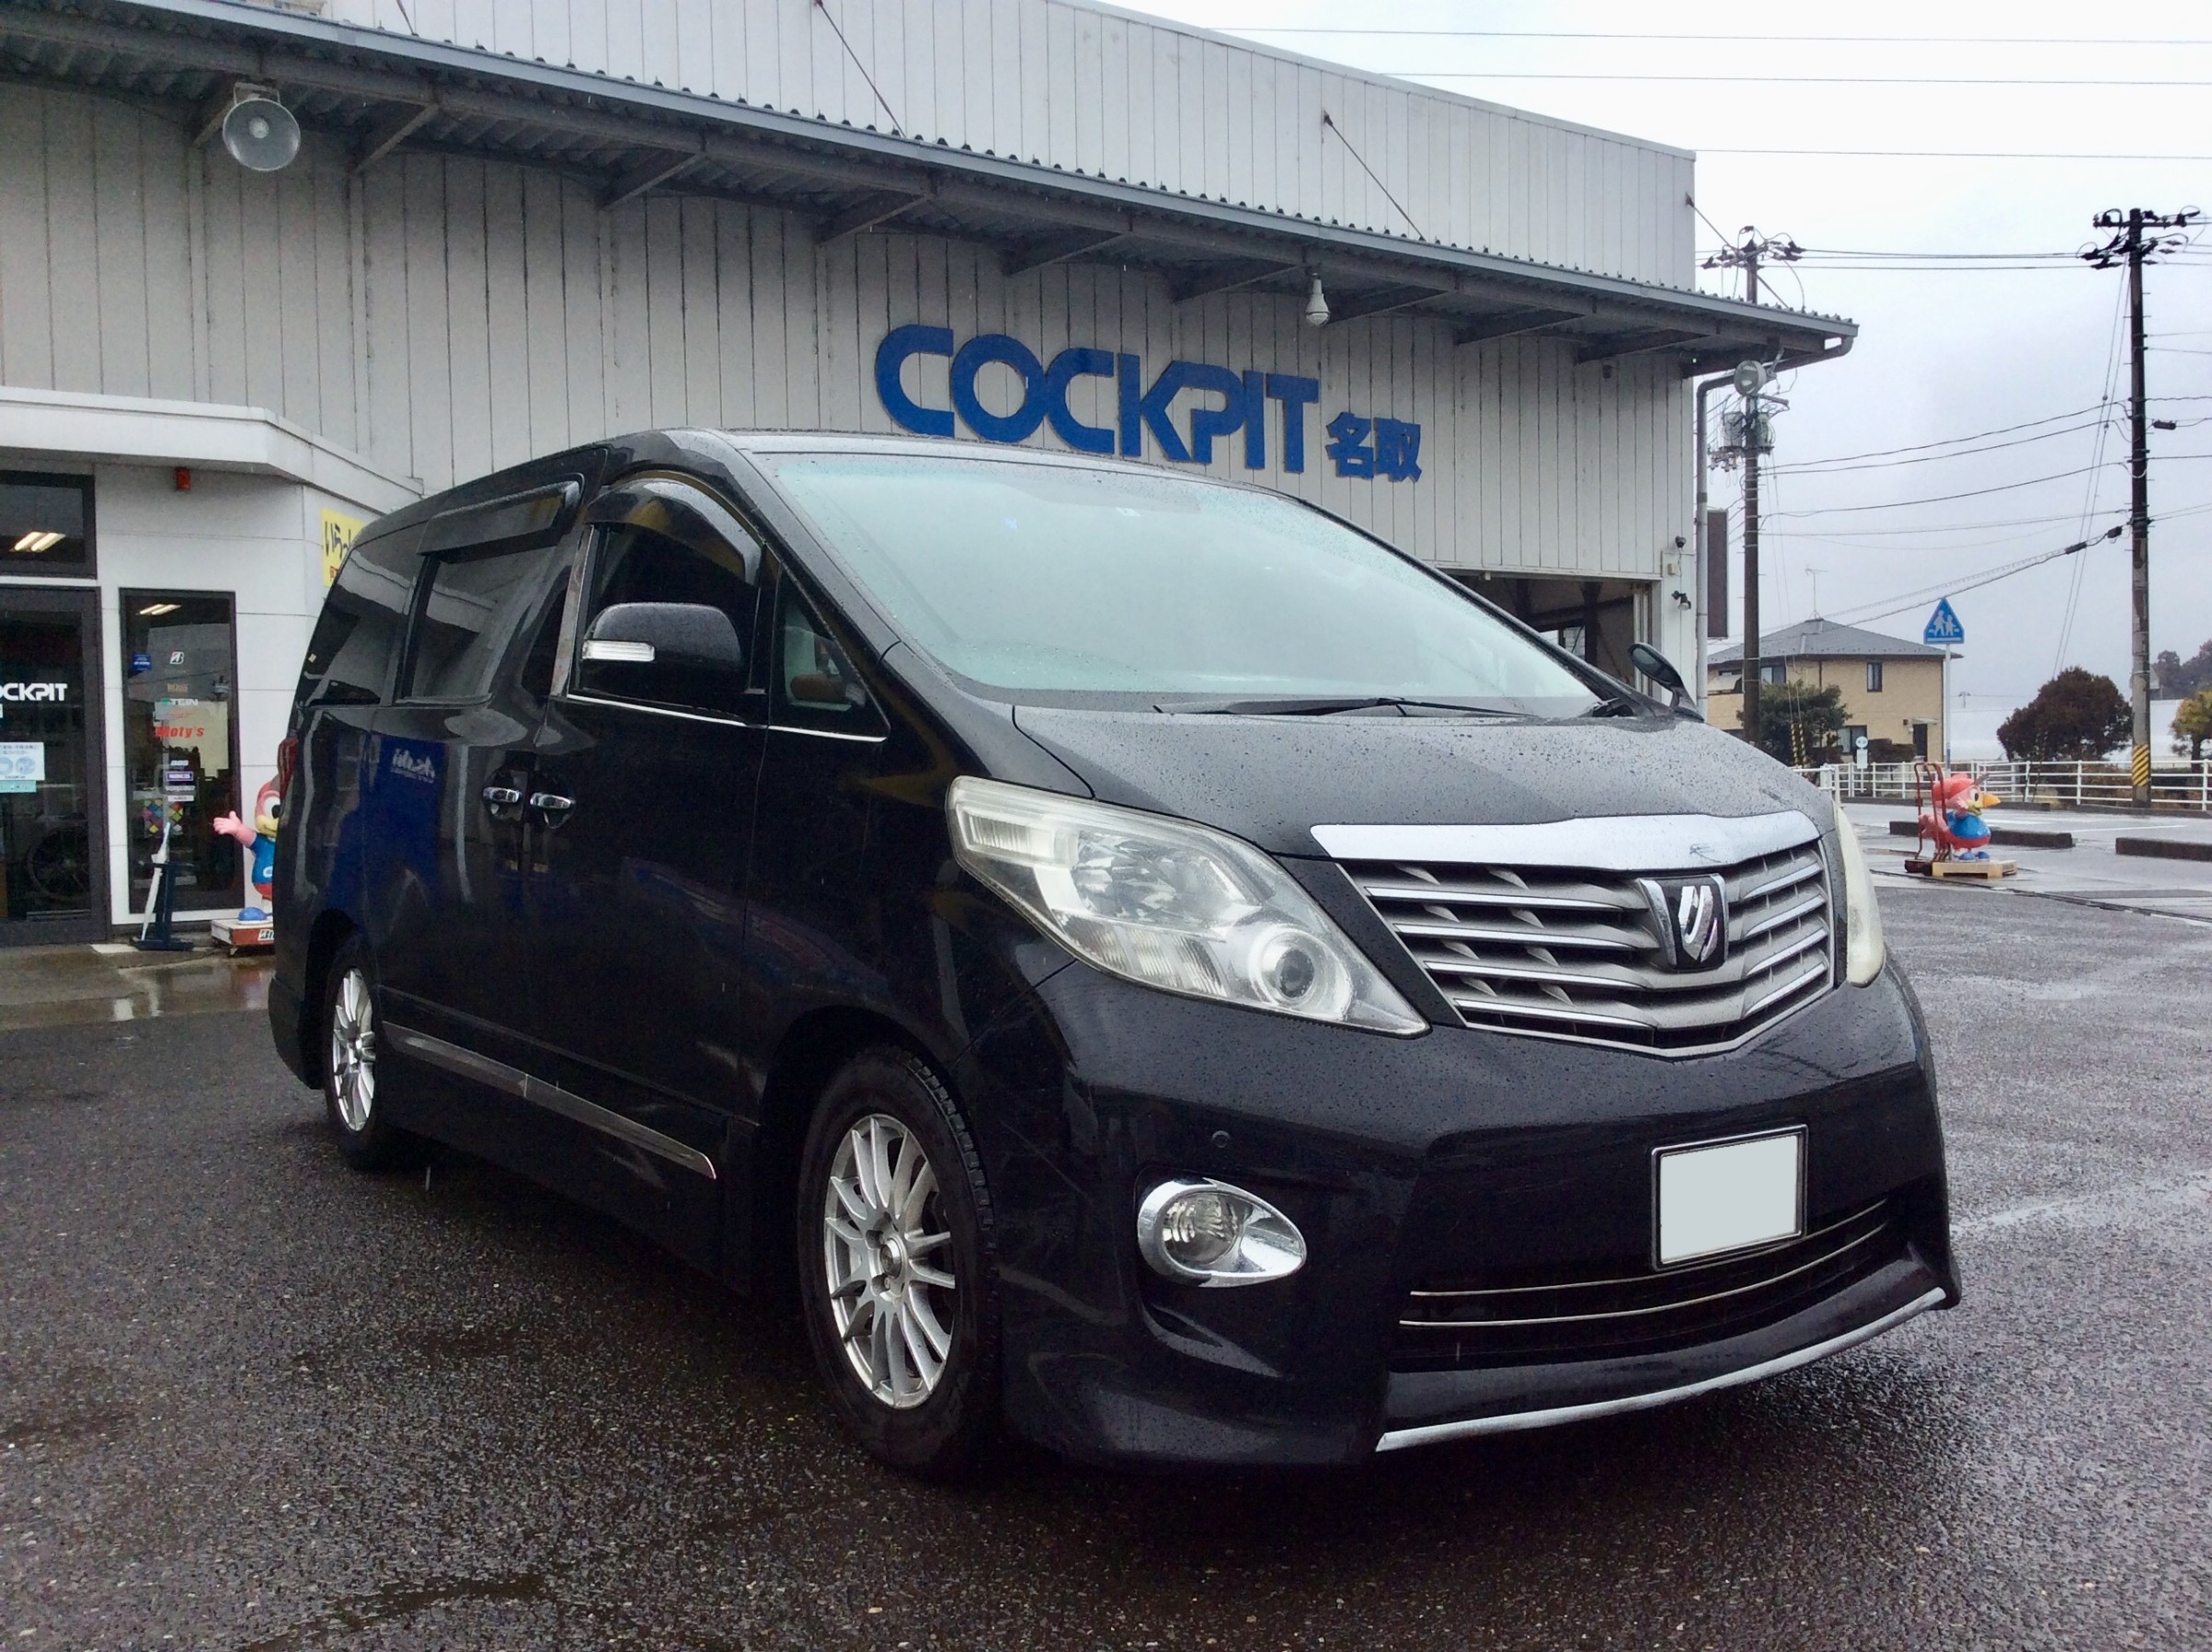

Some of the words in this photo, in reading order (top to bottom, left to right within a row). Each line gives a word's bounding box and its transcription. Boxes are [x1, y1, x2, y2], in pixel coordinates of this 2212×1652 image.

[876, 324, 1320, 474] COCKPIT
[1326, 411, 1423, 483] 名取
[0, 683, 68, 702] CKPIT
[170, 698, 199, 706] TEIN
